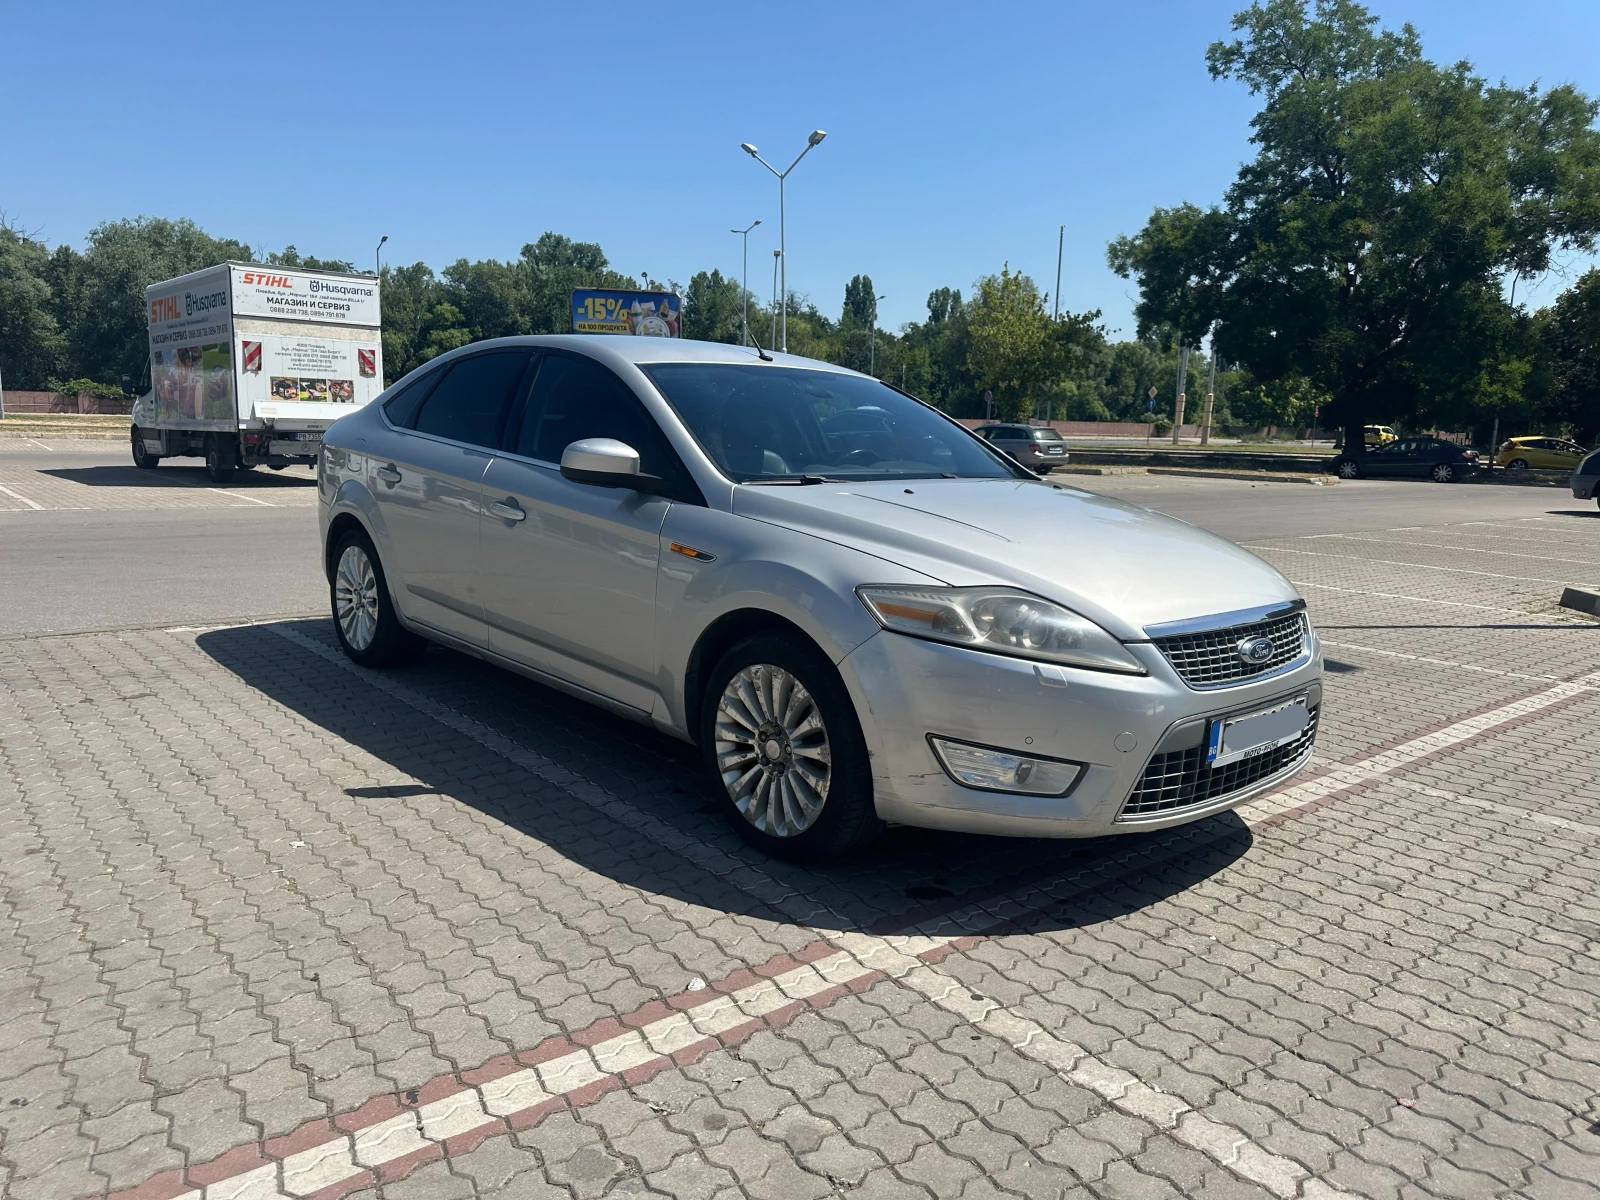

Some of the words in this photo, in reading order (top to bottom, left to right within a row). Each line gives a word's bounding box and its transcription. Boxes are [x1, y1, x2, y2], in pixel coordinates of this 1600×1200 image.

[243, 273, 292, 288] STIHL
[321, 282, 372, 296] Husqvarna
[192, 292, 226, 312] Husqvarna
[266, 296, 308, 307] МАГАЗИН
[318, 302, 350, 311] СЕРВИЗ
[578, 298, 628, 320] -15%
[151, 296, 180, 324] STIHL
[1255, 644, 1268, 658] Ford
[1208, 746, 1217, 756] BG
